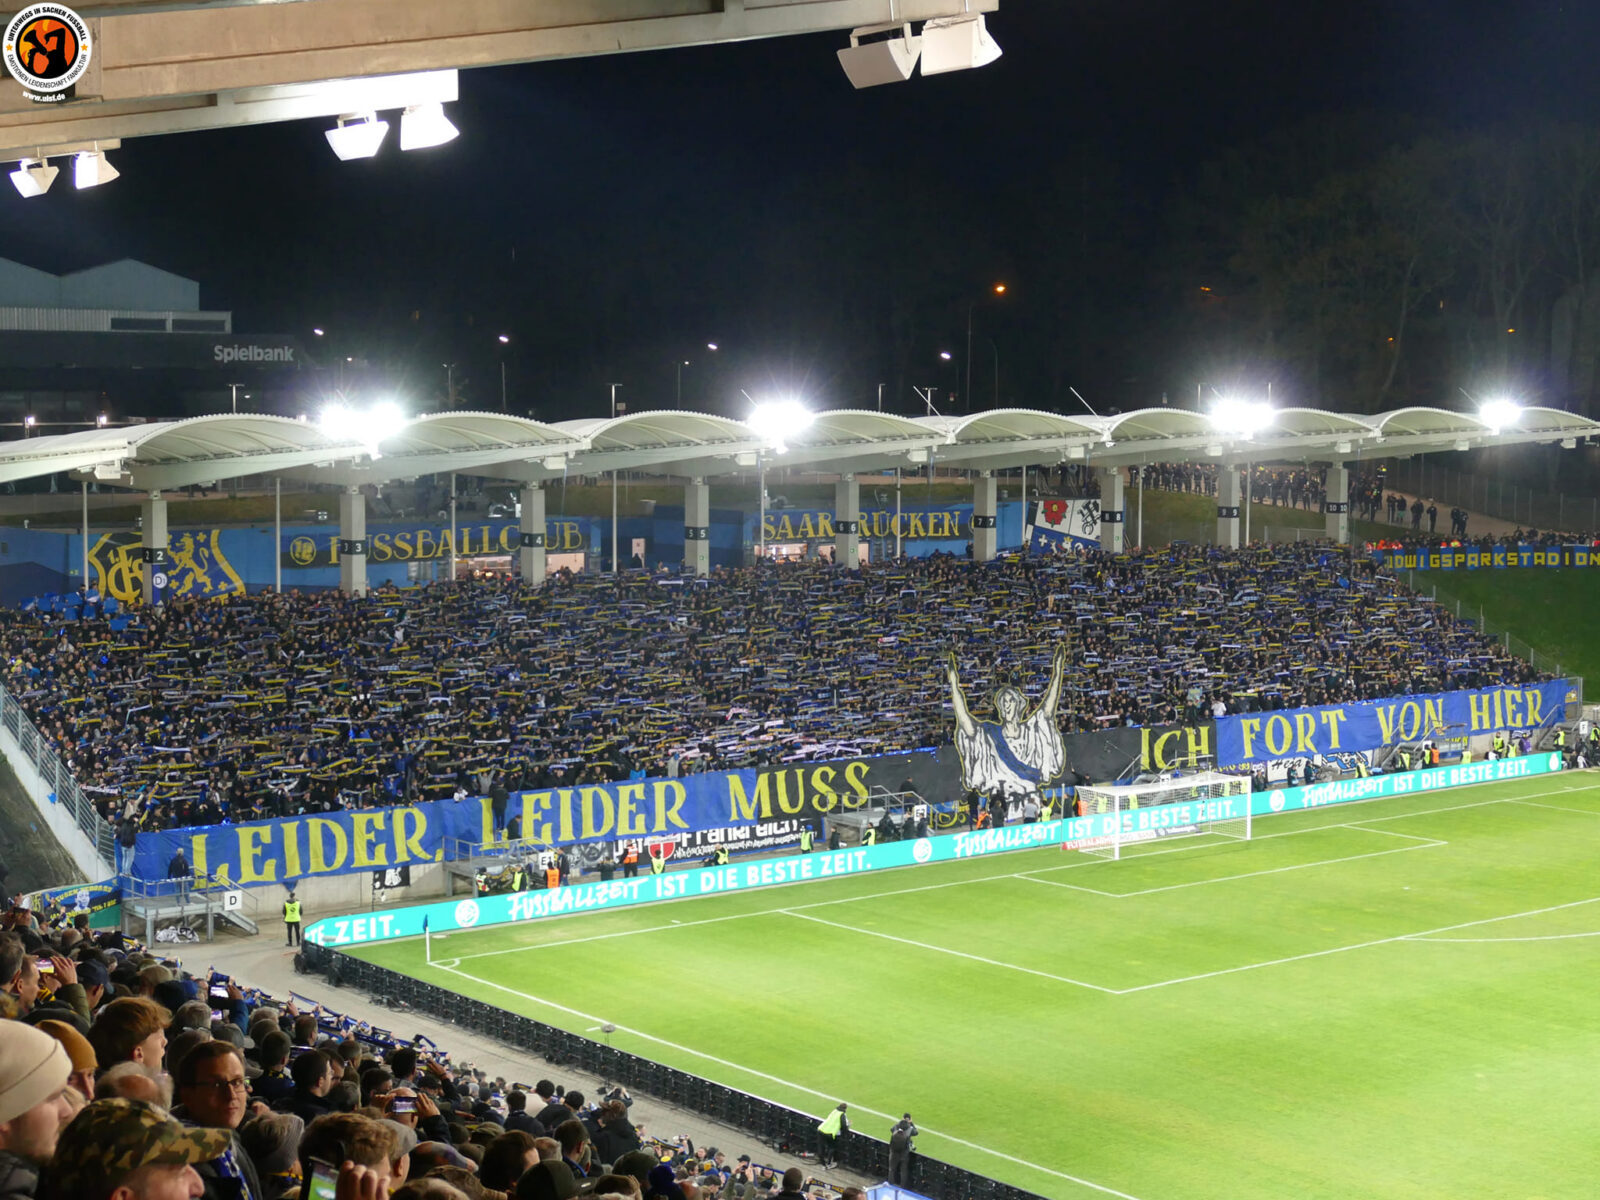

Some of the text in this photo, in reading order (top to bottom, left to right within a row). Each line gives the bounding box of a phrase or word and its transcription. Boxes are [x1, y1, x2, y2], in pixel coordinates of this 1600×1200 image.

[214, 344, 294, 363] Spielbank
[1116, 513, 1121, 521] 8
[1232, 508, 1237, 516] 9
[763, 511, 960, 541] SAARRÜCKEN
[851, 523, 856, 531] 6
[988, 518, 994, 526] 7
[700, 529, 706, 538] 5
[327, 522, 583, 564] FSSBALLCUB
[536, 535, 542, 545] 4
[355, 542, 362, 552] 3
[156, 550, 163, 561] 2
[478, 780, 690, 850] LEIDER
[727, 761, 870, 822] MUSS
[1141, 725, 1211, 774] ICH
[1241, 709, 1347, 759] FORT
[1376, 698, 1445, 745] VON
[1469, 689, 1543, 732] HIER
[1393, 772, 1416, 793] IST
[1421, 767, 1446, 789] DIE
[1451, 763, 1494, 786] BESTE
[1497, 758, 1531, 778] ZEIT.
[953, 821, 1062, 858] FUSSBALLZEIT
[1068, 819, 1094, 840] IST
[1103, 814, 1133, 835] DE
[1138, 806, 1190, 830] BESTE
[1196, 800, 1237, 823] ZEIT.
[506, 851, 872, 921] FUSSBALLZEIT IST DIE BESTE ZEIT.
[229, 895, 237, 905] D
[334, 914, 401, 944] ZEIT.
